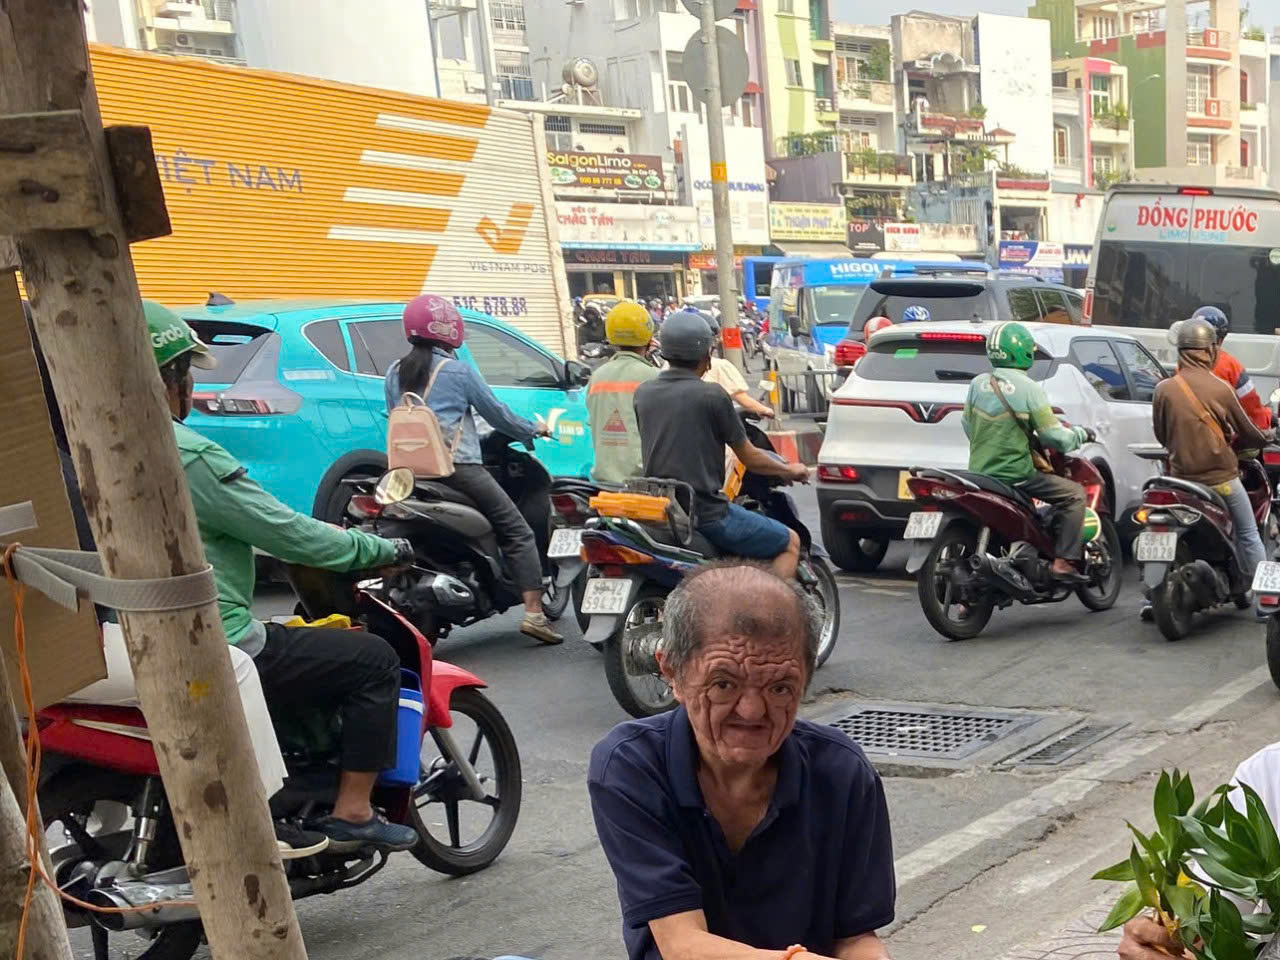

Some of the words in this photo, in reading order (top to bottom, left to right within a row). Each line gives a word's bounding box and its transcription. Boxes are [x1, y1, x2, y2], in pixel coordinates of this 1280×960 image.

[547, 152, 632, 168] SaigonLimo
[227, 161, 304, 194] NAM
[1192, 205, 1258, 233] PHƯỚC
[151, 324, 185, 348] Grab
